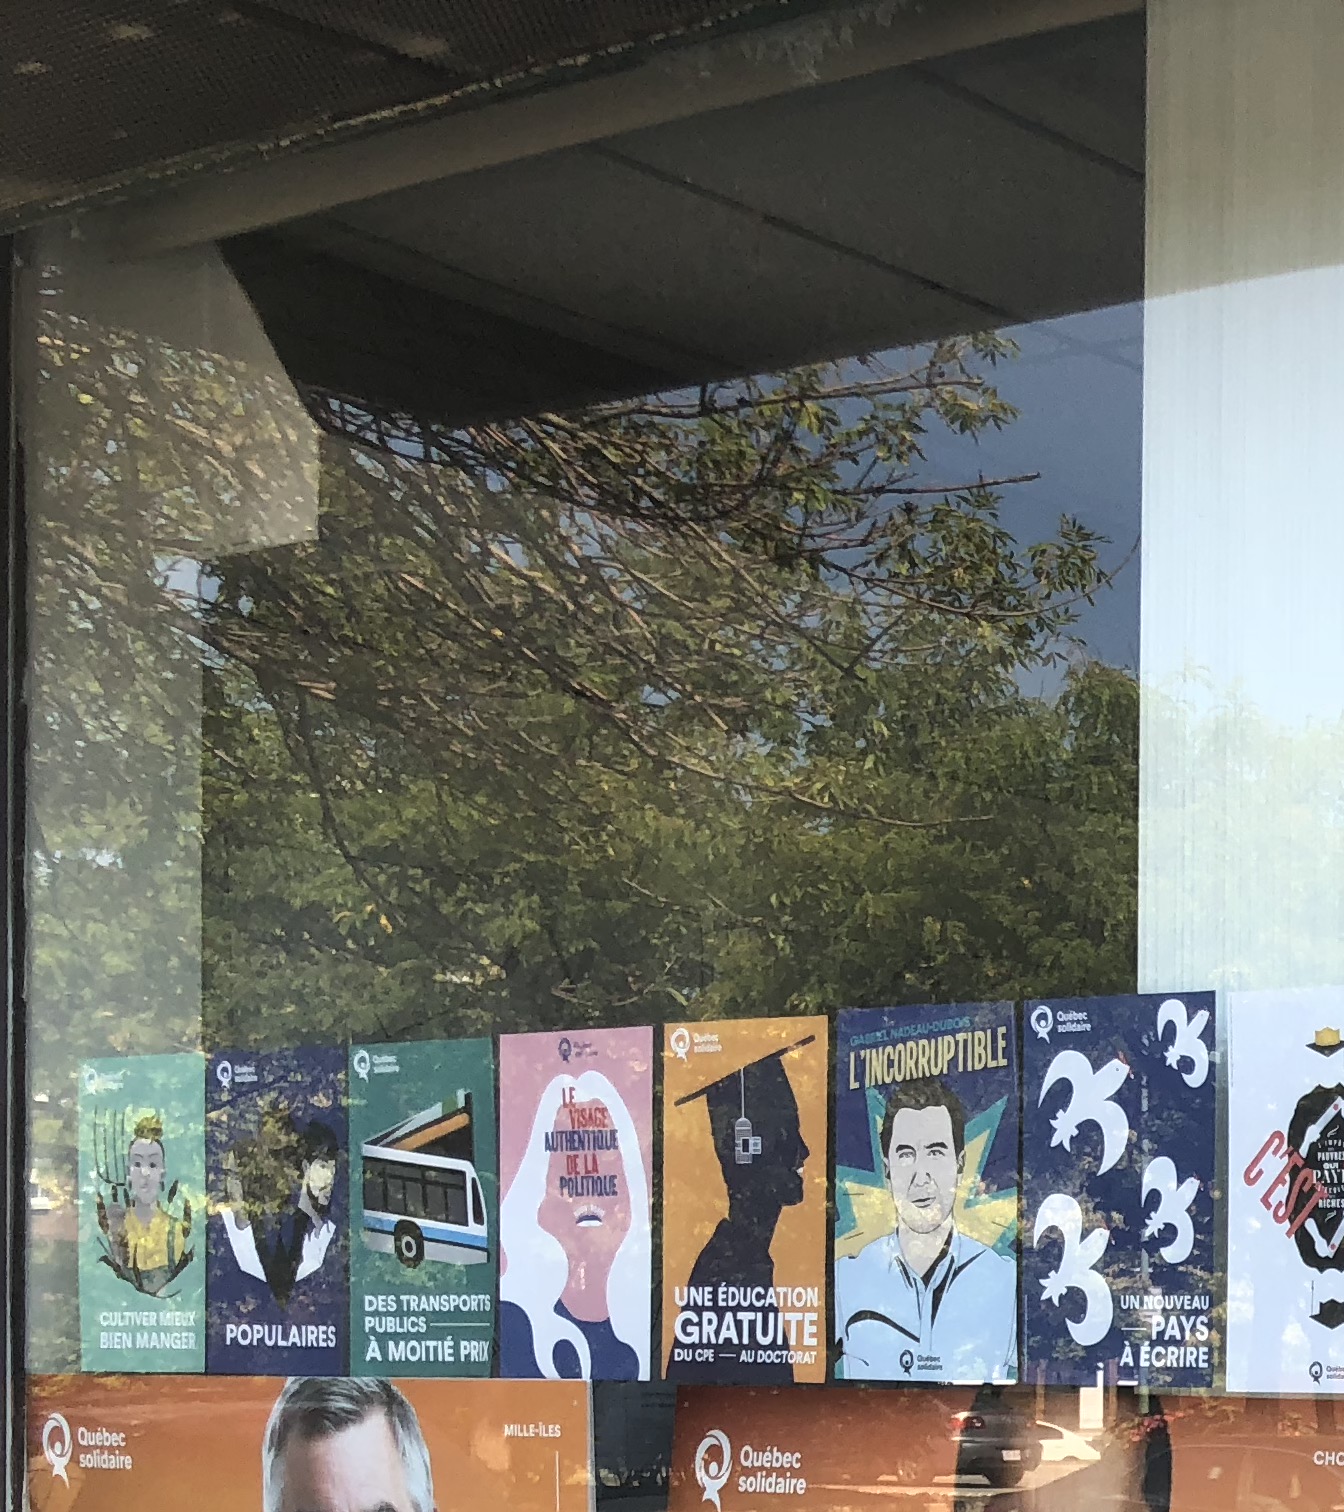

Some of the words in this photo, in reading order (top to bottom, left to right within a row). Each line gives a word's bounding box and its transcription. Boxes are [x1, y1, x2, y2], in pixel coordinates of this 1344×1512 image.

[849, 1026, 1007, 1090] L'INCORRUPTIBLE
[562, 1087, 576, 1108] LE
[569, 1107, 608, 1129] VISAGE
[544, 1129, 619, 1152] AUTHENTIQUE
[566, 1154, 580, 1175] DE
[584, 1153, 599, 1175] LA
[559, 1175, 618, 1198] POLITIQUE
[1243, 1130, 1329, 1239] C'EST
[364, 1295, 397, 1312] DES
[400, 1295, 491, 1312] TRANSPORTS
[674, 1286, 713, 1306] UNE
[718, 1282, 818, 1307] ÉDUCATION
[1120, 1295, 1139, 1309] UN
[1143, 1295, 1209, 1310] NOUVEAU
[100, 1312, 156, 1326] CULTIVER
[364, 1316, 427, 1333] PUBLICS
[674, 1311, 818, 1346] GRATUITE
[1151, 1315, 1209, 1341] PAYS
[100, 1332, 132, 1349] BIEN
[136, 1332, 197, 1350] MANGER
[226, 1323, 336, 1347] POPULAIRES
[365, 1335, 382, 1361] À
[388, 1335, 454, 1361] MOITIÉ
[460, 1340, 490, 1361] PRIX
[674, 1349, 692, 1361] DU
[695, 1349, 715, 1362] CPE
[739, 1350, 754, 1363] AU
[757, 1350, 817, 1364] DOCTORAT
[1120, 1341, 1134, 1366] À
[1140, 1341, 1209, 1368] ÉCRIRE
[78, 1426, 126, 1447] Québec
[504, 1422, 561, 1437] MILLE-ÎLES
[79, 1449, 133, 1469] solidaire
[740, 1444, 801, 1469] Québec
[738, 1471, 806, 1495] solidaire
